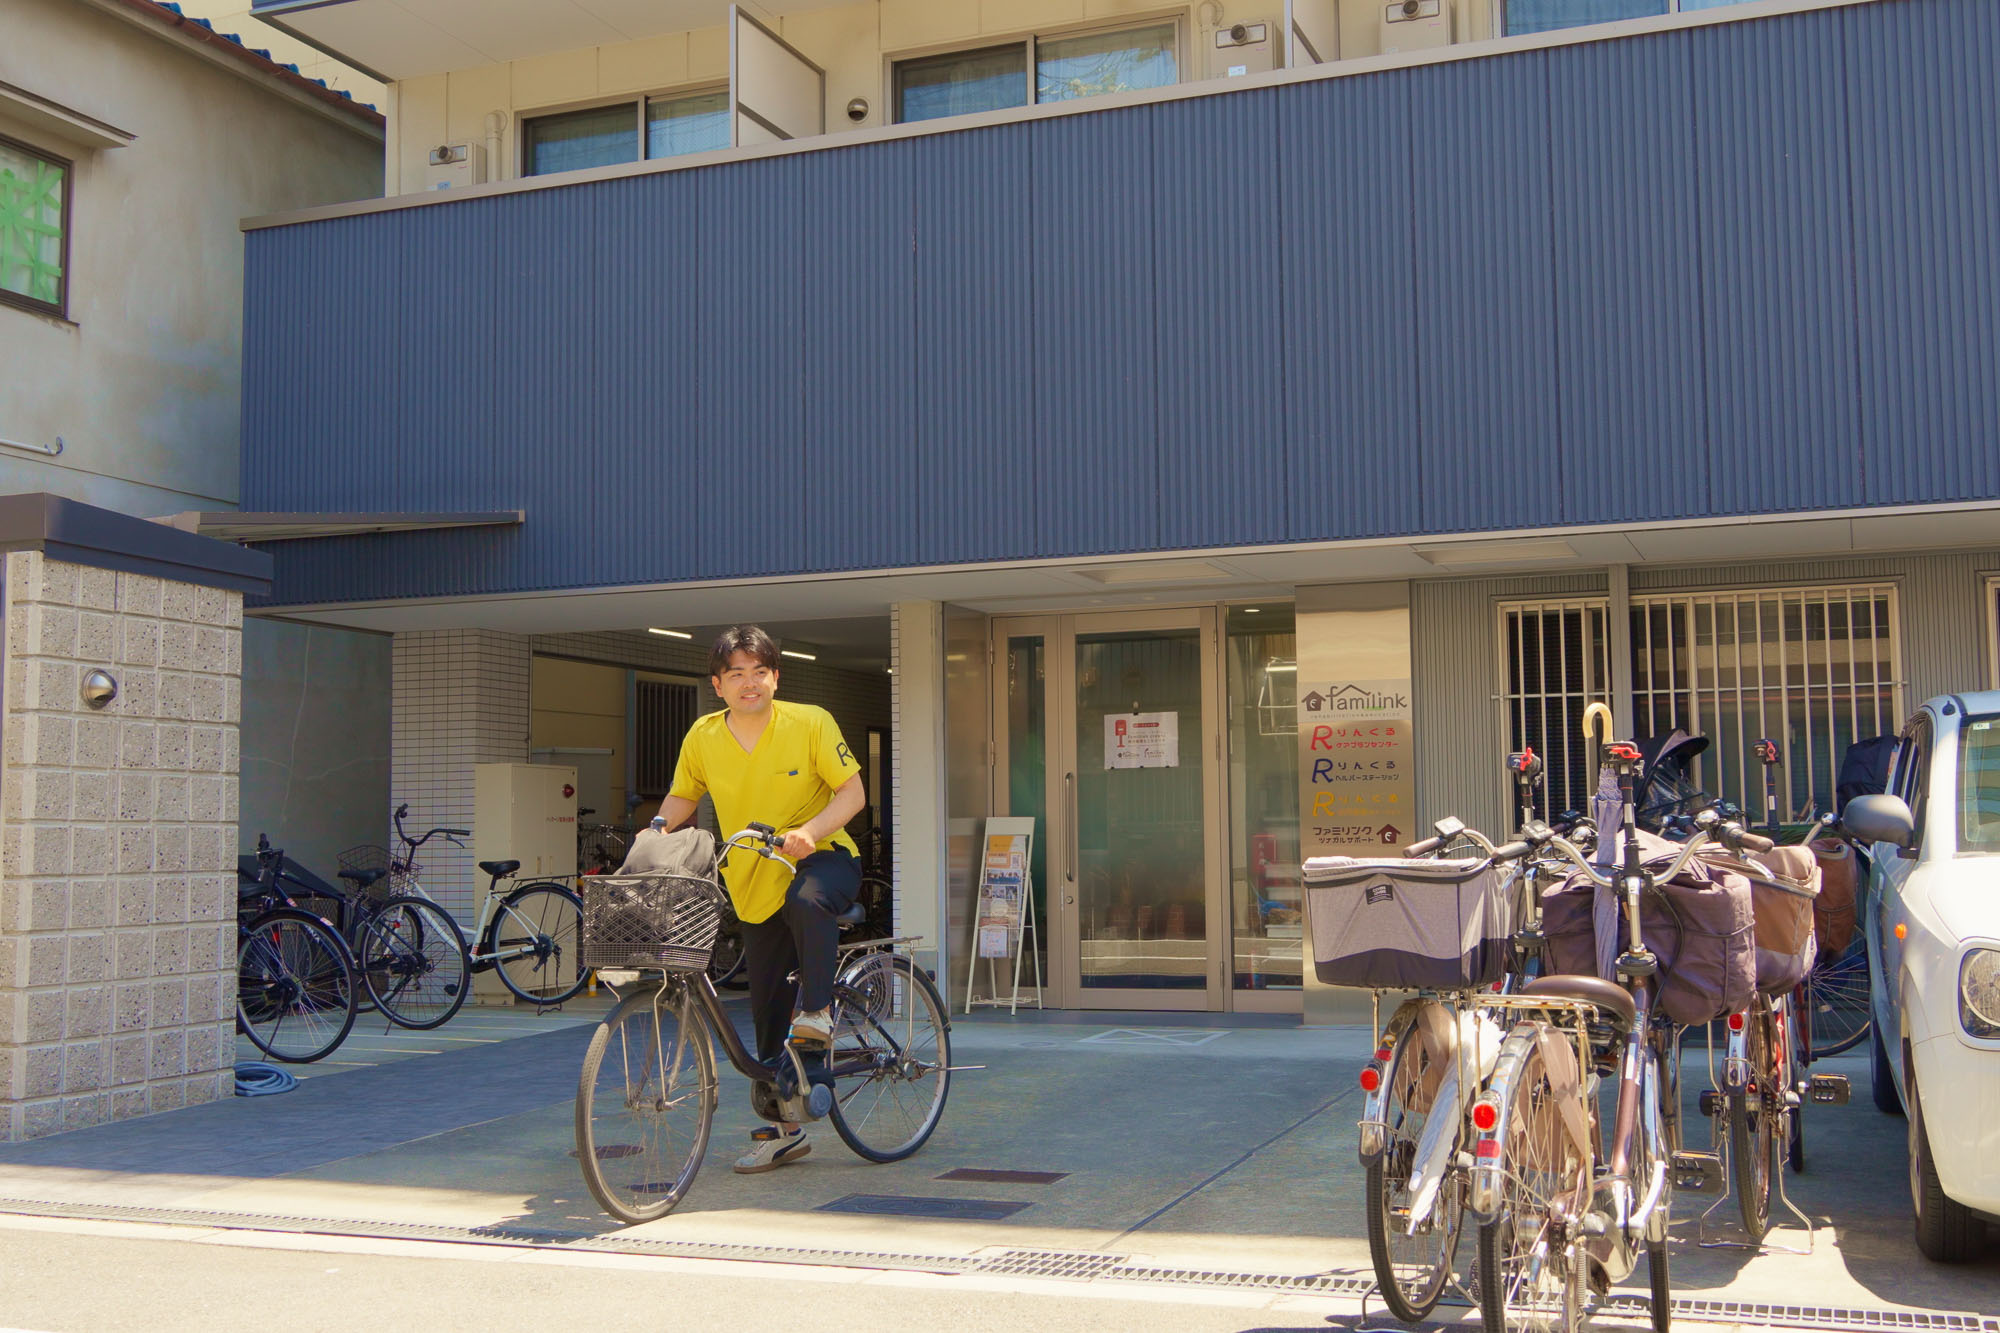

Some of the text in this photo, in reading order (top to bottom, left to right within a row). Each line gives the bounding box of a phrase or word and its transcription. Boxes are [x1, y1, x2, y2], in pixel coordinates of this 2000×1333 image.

[1325, 684, 1407, 711] familink
[1311, 725, 1396, 750] R りんくる
[836, 742, 854, 766] R
[1312, 758, 1396, 783] R りんくる
[1312, 791, 1335, 817] R
[1312, 826, 1372, 836] ファミリンク
